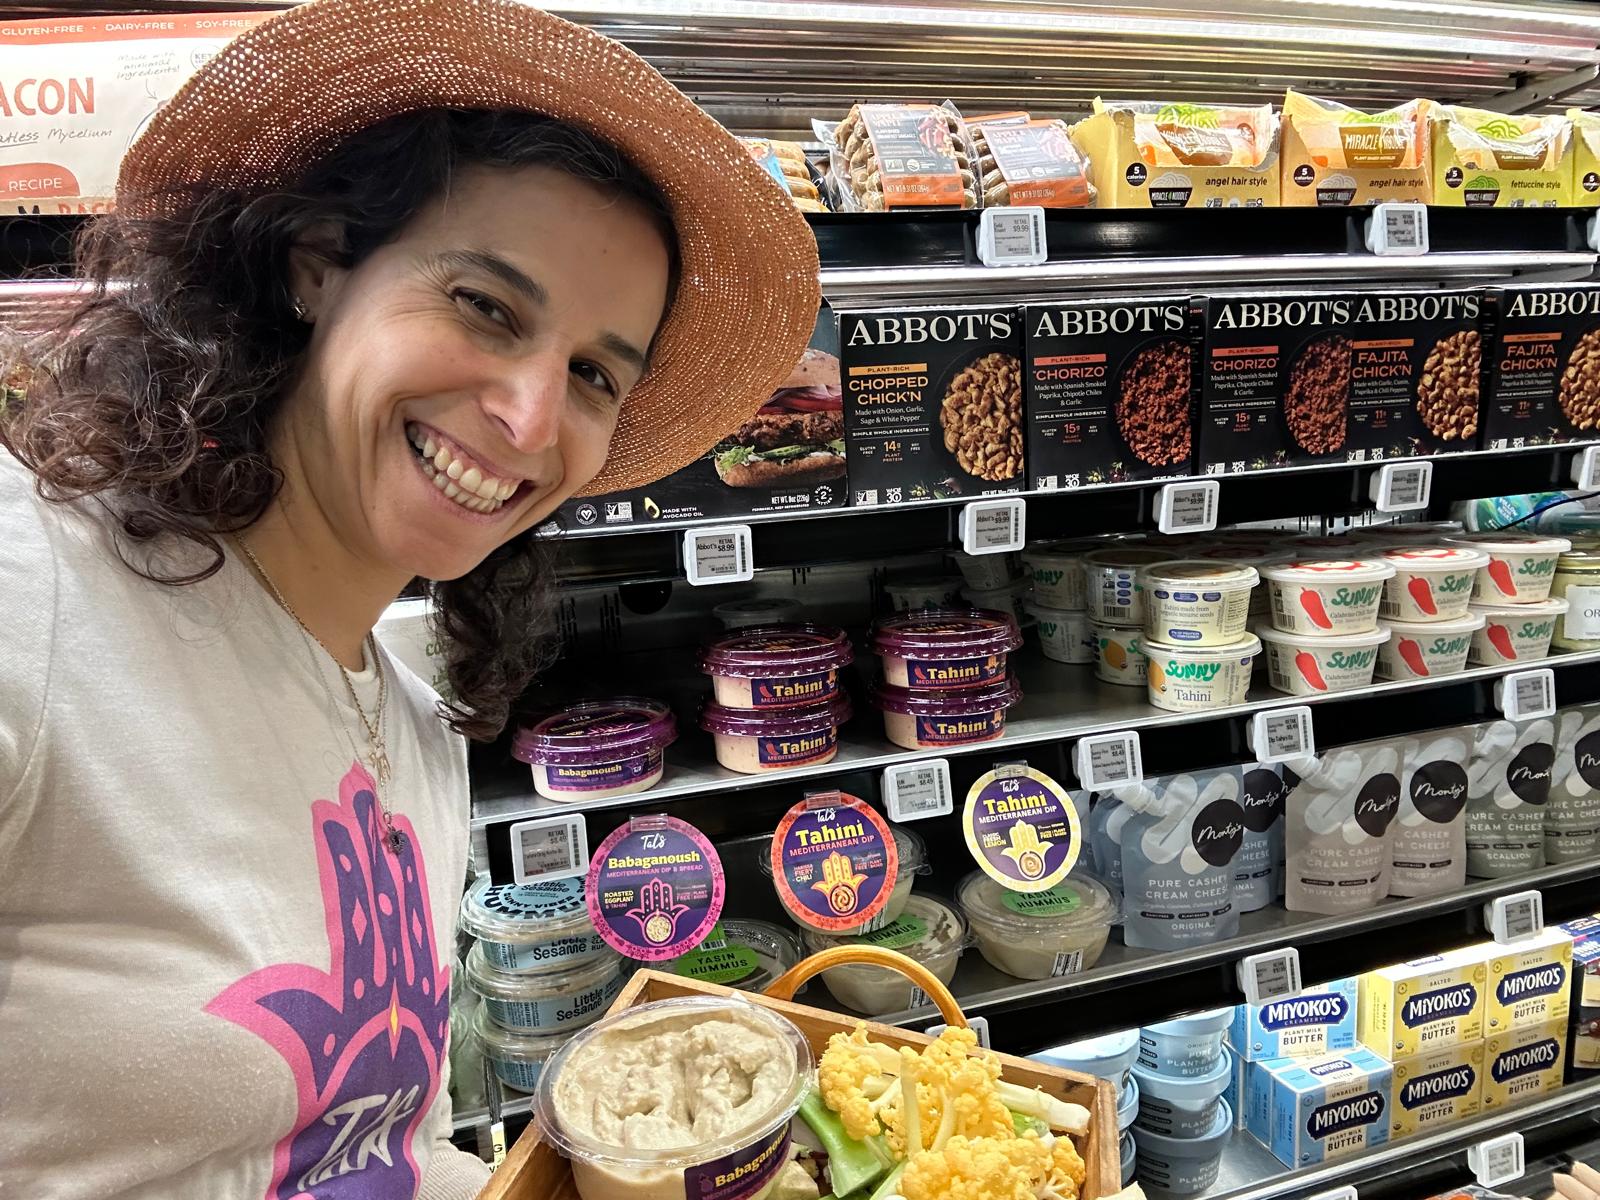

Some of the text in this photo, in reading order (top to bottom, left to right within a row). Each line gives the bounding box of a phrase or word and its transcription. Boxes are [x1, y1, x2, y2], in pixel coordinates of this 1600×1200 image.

[2, 20, 252, 36] GLUTEN-FREE DAIRY-FREE SOY-FREE
[0, 77, 95, 117] ACON
[48, 128, 112, 144] Mycelium
[1345, 134, 1377, 149] MIRACLE
[1134, 166, 1140, 174] 5
[9, 177, 63, 191] RECIPE
[1206, 177, 1268, 186] angel hair style
[1370, 178, 1423, 188] angel hair style
[1511, 180, 1561, 188] fettuccine style
[1354, 295, 1479, 323] ABBOT'S
[1506, 291, 1600, 318] ABBOT
[1213, 300, 1350, 329] ABBOT'S
[1033, 305, 1184, 338] ABBOT'S
[847, 312, 1012, 346] ABBOT'S
[1507, 344, 1555, 356] FAJITA
[1358, 351, 1408, 363] FAJITA
[1501, 358, 1558, 371] CHICK'N
[1352, 365, 1412, 379] CHICK'N
[849, 376, 929, 391] CHOPPED
[1063, 382, 1084, 390] Spanish
[857, 391, 922, 405] CHICK'N
[1039, 391, 1062, 399] Paprika,
[1063, 390, 1085, 398] Chipotle
[900, 415, 920, 423] Pepper
[1065, 479, 1080, 488] 30
[772, 496, 780, 504] NET
[820, 491, 827, 500] 2
[886, 492, 902, 503] 30
[697, 543, 735, 552] Abbot's $8.99
[1332, 585, 1381, 606] SUNNY
[1326, 649, 1377, 669] SUNNY
[927, 664, 980, 680] Tahini
[1165, 660, 1222, 681] SUNNY
[916, 676, 970, 685] MEDITERRANEAN
[773, 679, 823, 697] Tahini
[761, 692, 815, 703] MEDITERRANEAN
[1174, 689, 1211, 702] Tahini
[937, 719, 987, 735] Tahini
[925, 732, 979, 740] MEDITERRANEAN
[780, 735, 826, 755] Tahini
[767, 749, 819, 761] MEDITERRANEAN
[558, 764, 622, 778] Babaganoush
[1512, 766, 1550, 781] Mont
[1415, 782, 1465, 799] Monty's
[983, 791, 1048, 815] Tahini
[1243, 792, 1280, 808] Monty's
[979, 805, 1057, 823] MEDITERRANEAN DIP
[796, 820, 865, 847] Tahini
[1197, 822, 1242, 843] Monty's
[641, 833, 667, 850] Tal's
[790, 835, 875, 856] MEDITERRANEAN DIP
[984, 839, 1007, 848] LEMON
[1242, 849, 1270, 861] HEESE
[1310, 849, 1343, 857] PURE
[1487, 852, 1531, 861] SCALLION
[608, 851, 700, 869] Babaganoush
[1307, 859, 1349, 867] CREAM
[607, 868, 660, 878] MEDITERRANEAN
[796, 874, 812, 882] CHILI
[521, 885, 570, 893] Sesame
[1149, 879, 1181, 888] PURE
[604, 890, 634, 898] ROASTED
[1019, 890, 1055, 900] YASIN
[1146, 890, 1188, 899] CREAM
[1302, 887, 1346, 898] TRUFFLE
[1016, 897, 1071, 909] HUMMUS
[866, 923, 917, 943] HUMMUS
[533, 943, 586, 960] Sesame
[697, 952, 736, 964] YASIN
[1523, 957, 1543, 966] SALTED
[690, 958, 748, 975] HUMMUS
[1430, 978, 1451, 987] SALTED
[574, 988, 603, 1008] Little
[557, 998, 602, 1021] Sesame
[1514, 1004, 1546, 1019] BUTTER
[1515, 1002, 1532, 1010] PLANT
[1284, 1016, 1325, 1026] CREAMERY
[1422, 1023, 1441, 1031] PLANT
[1284, 1028, 1305, 1036] PLANT
[1421, 1026, 1456, 1041] BUTTER
[1283, 1034, 1324, 1046] BUTTER
[1518, 1034, 1538, 1043] SALTED
[1428, 1060, 1450, 1069] SALTED
[1331, 1085, 1363, 1098] UNSALTED
[1508, 1080, 1540, 1095] BUTTER
[1419, 1106, 1453, 1122] BUTTER
[1420, 1105, 1439, 1113] PLANT
[1328, 1135, 1363, 1152] BUTTER
[1329, 1134, 1347, 1142] PLANT
